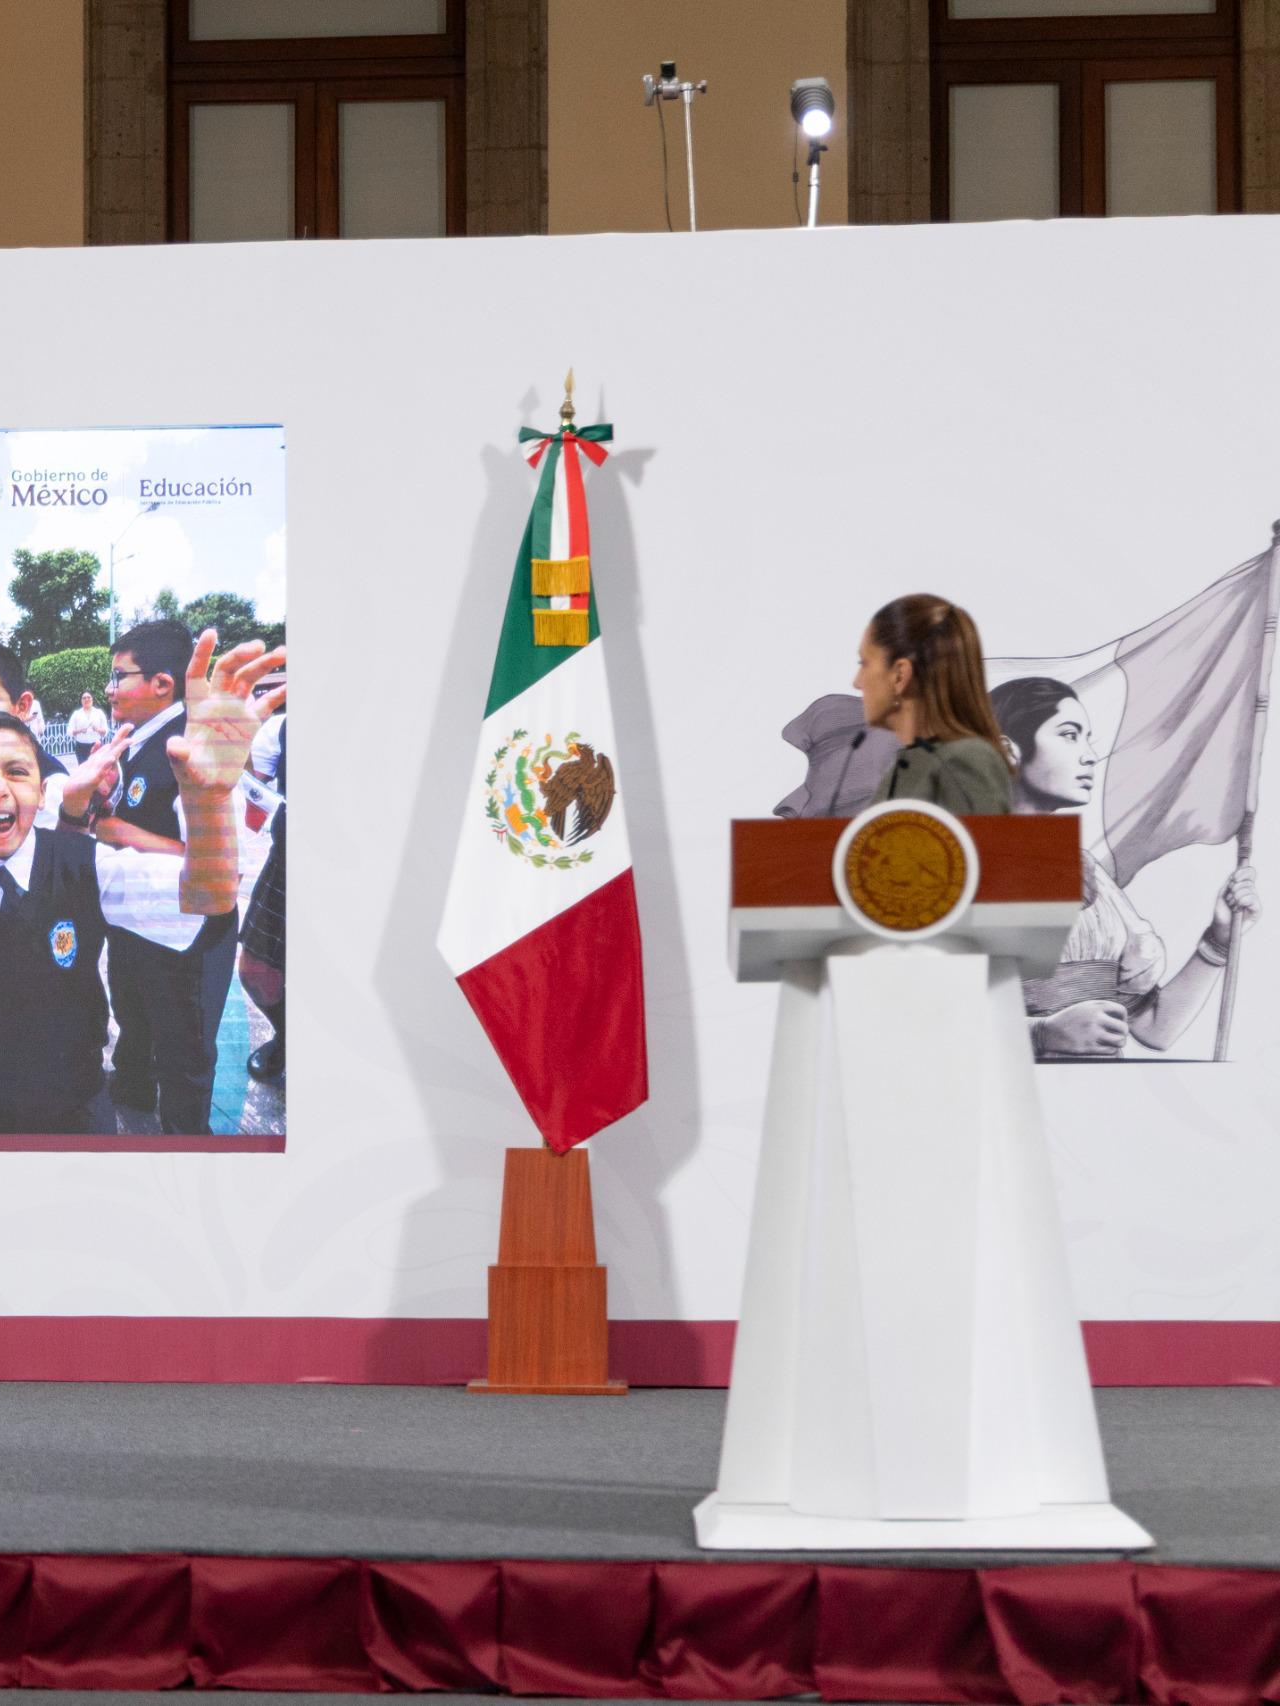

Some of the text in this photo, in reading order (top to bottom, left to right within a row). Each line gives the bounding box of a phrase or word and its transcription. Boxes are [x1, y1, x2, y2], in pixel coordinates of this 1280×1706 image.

[11, 468, 108, 482] Gobierno de
[11, 483, 108, 507] México
[139, 476, 253, 498] Educación
